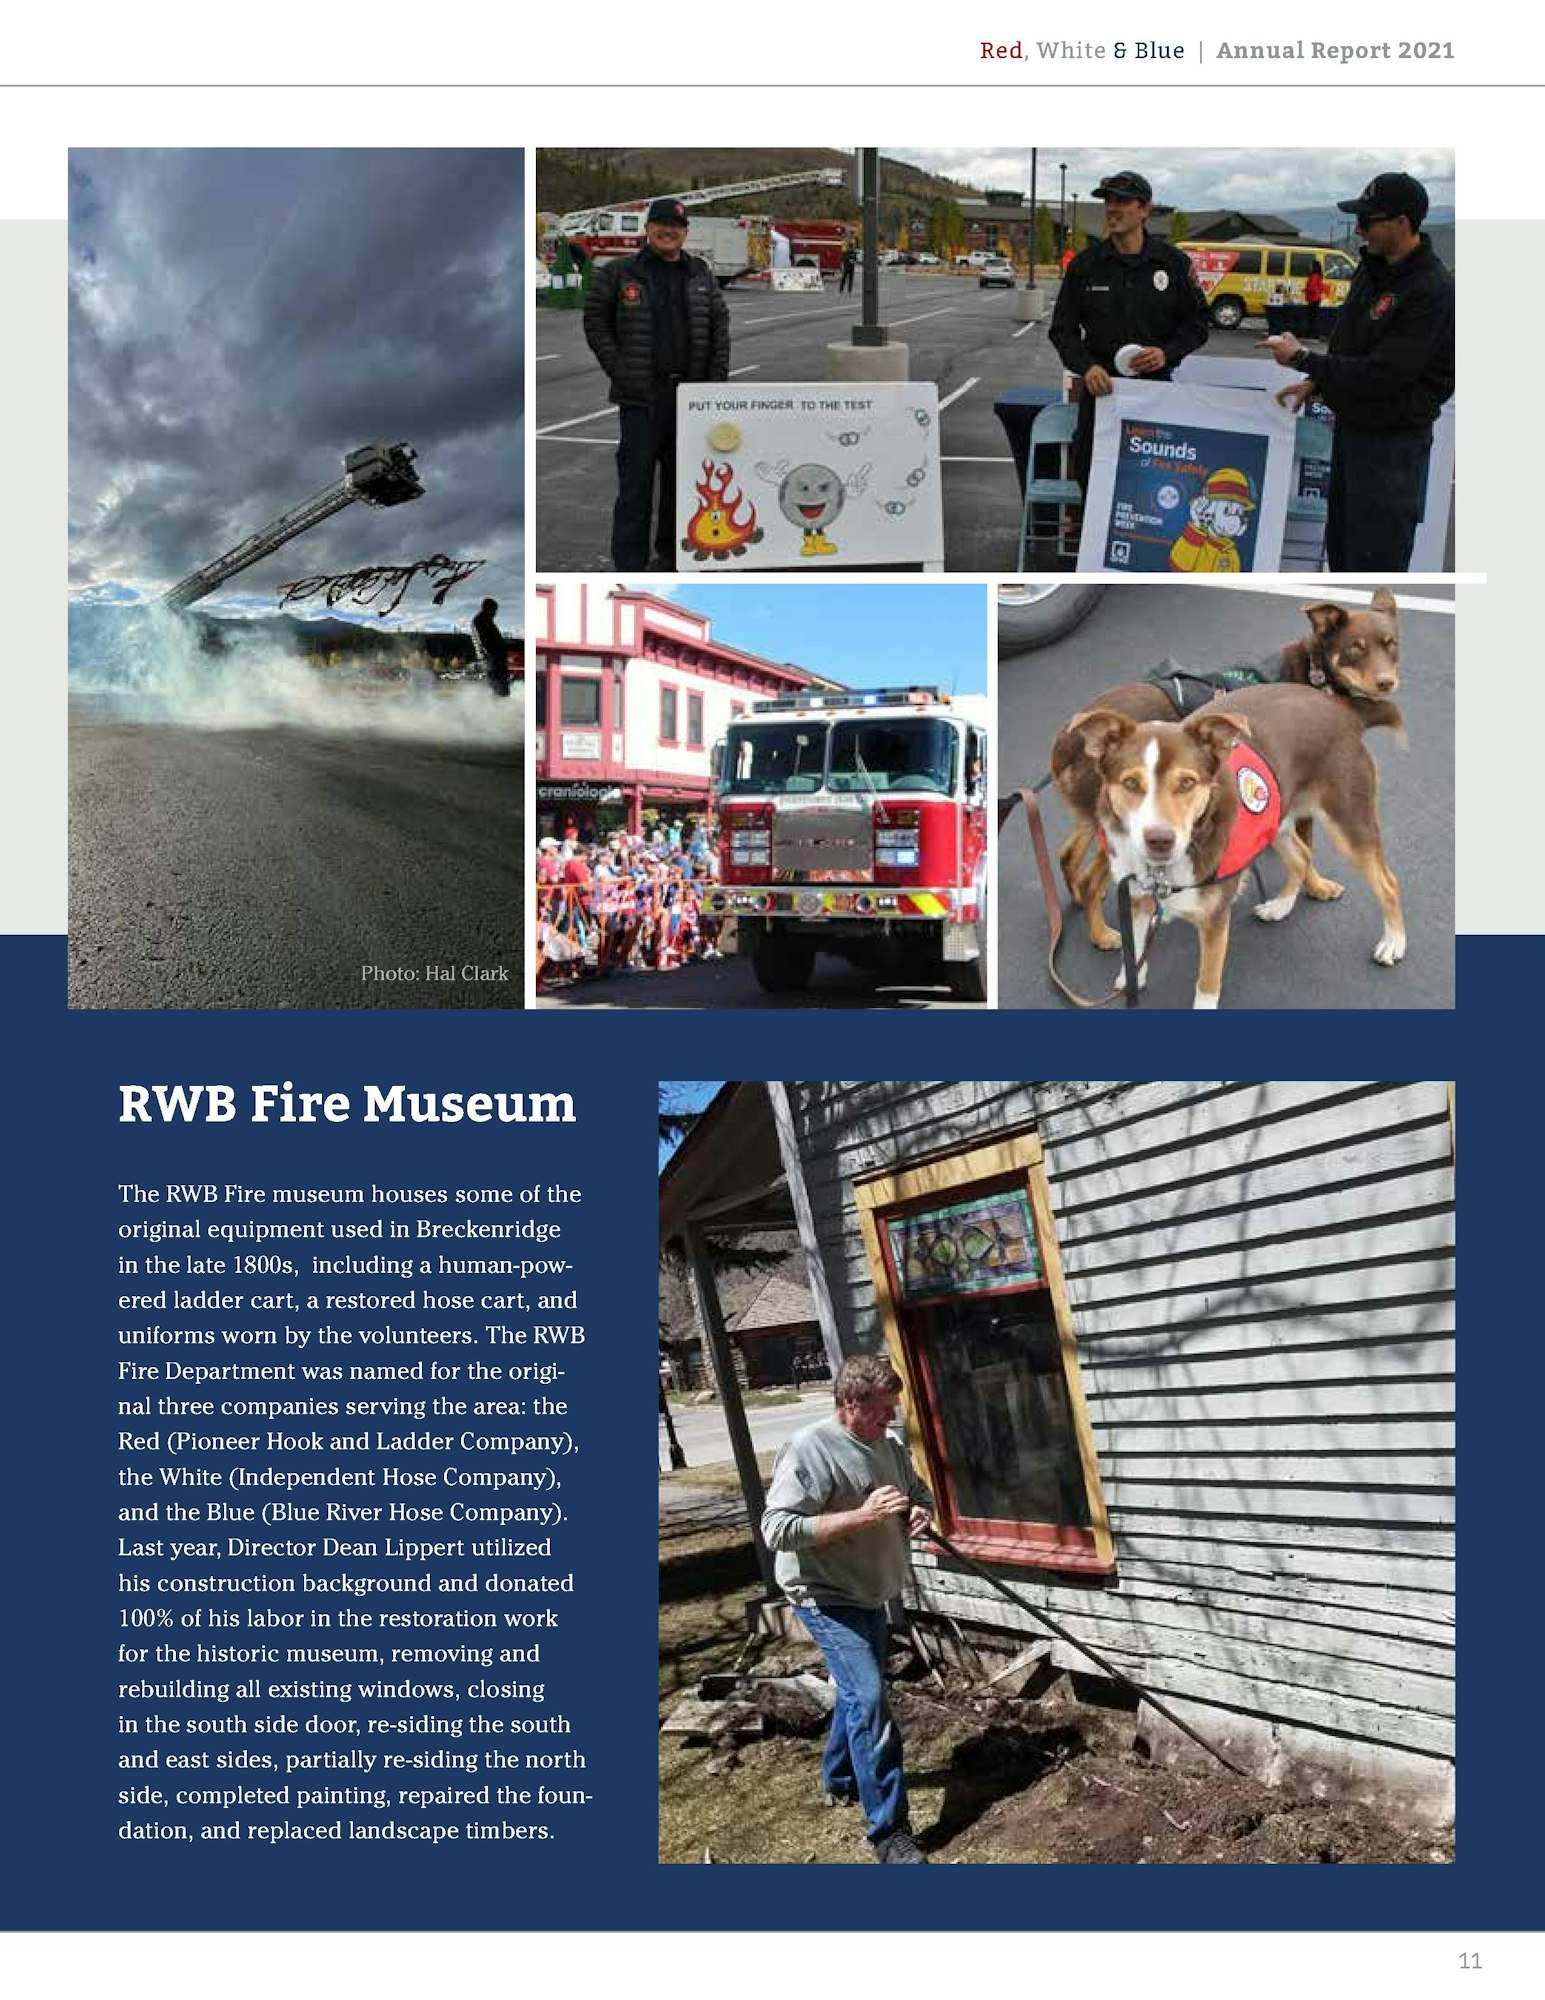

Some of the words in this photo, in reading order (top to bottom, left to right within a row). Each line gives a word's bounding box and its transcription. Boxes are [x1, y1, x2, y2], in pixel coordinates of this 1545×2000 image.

[980, 41, 1028, 61] Red,
[1036, 41, 1105, 58] White
[1114, 42, 1127, 58] &
[1135, 41, 1184, 58] Blue
[1216, 41, 1304, 58] Annual
[1311, 42, 1391, 64] Report
[1399, 42, 1454, 58] 2021
[688, 401, 711, 411] PUT
[715, 401, 748, 410] YOUR
[750, 400, 794, 410] FINGER
[801, 401, 815, 411] TO
[819, 401, 839, 411] THE
[844, 401, 872, 410] TEST
[1129, 436, 1197, 460] Sounds
[120, 1084, 236, 1122] RWB
[252, 1081, 350, 1122] Fire
[363, 1085, 576, 1122] Museum
[118, 1184, 160, 1203] The
[166, 1184, 217, 1203] RWB
[224, 1184, 265, 1203] Fire
[273, 1189, 364, 1204] museum
[372, 1184, 448, 1204] houses
[455, 1189, 513, 1204] some
[519, 1184, 540, 1203] of
[547, 1184, 582, 1203] the
[118, 1220, 200, 1242] original
[207, 1220, 325, 1242] equipment
[330, 1219, 383, 1239] used
[390, 1220, 410, 1237] in
[417, 1219, 560, 1242] Breckenridge
[119, 1257, 139, 1274] in
[145, 1254, 181, 1274] the
[187, 1255, 225, 1274] late
[234, 1254, 299, 1277] 1800s,
[312, 1254, 414, 1279] including
[419, 1260, 432, 1274] a
[439, 1254, 573, 1279] human-pow-
[118, 1290, 166, 1309] ered
[174, 1290, 243, 1310] ladder
[250, 1292, 299, 1313] cart,
[306, 1295, 319, 1310] a
[326, 1290, 416, 1310] restored
[423, 1290, 475, 1310] hose
[480, 1292, 530, 1313] cart,
[538, 1290, 577, 1310] and
[118, 1325, 216, 1344] uniforms
[221, 1330, 277, 1344] worn
[285, 1326, 311, 1348] by
[318, 1326, 353, 1344] the
[358, 1326, 477, 1345] volunteers.
[486, 1325, 527, 1344] The
[534, 1325, 586, 1344] RWB
[118, 1361, 159, 1381] Fire
[166, 1361, 296, 1385] Department
[301, 1366, 343, 1381] was
[350, 1361, 423, 1381] named
[430, 1361, 460, 1381] for
[468, 1361, 503, 1380] the
[508, 1363, 565, 1385] origi-
[118, 1396, 151, 1416] nal
[158, 1397, 215, 1415] three
[221, 1398, 339, 1420] companies
[345, 1398, 427, 1420] serving
[432, 1396, 467, 1415] the
[473, 1401, 525, 1416] area:
[533, 1397, 568, 1416] the
[118, 1431, 160, 1451] Red
[167, 1431, 261, 1455] (Pioneer
[267, 1431, 324, 1451] Hook
[329, 1432, 369, 1451] and
[377, 1431, 455, 1451] Ladder
[460, 1431, 579, 1455] Company),
[118, 1467, 153, 1486] the
[159, 1467, 222, 1487] White
[229, 1467, 376, 1491] (Independent
[383, 1467, 437, 1487] Hose
[443, 1467, 560, 1491] Company),
[118, 1503, 159, 1521] and
[166, 1503, 201, 1522] the
[207, 1502, 254, 1521] Blue
[261, 1502, 320, 1526] (Blue
[326, 1502, 382, 1521] River
[389, 1502, 444, 1522] Hose
[450, 1502, 568, 1526] Company).
[118, 1538, 164, 1556] Last
[169, 1542, 221, 1560] year,
[228, 1537, 317, 1557] Director
[323, 1537, 377, 1557] Dean
[385, 1538, 464, 1561] Lippert
[472, 1538, 551, 1557] utilized
[119, 1573, 150, 1593] his
[158, 1575, 296, 1593] construction
[303, 1573, 431, 1597] background
[438, 1573, 478, 1592] and
[485, 1573, 574, 1592] donated
[120, 1608, 174, 1628] 100%
[181, 1609, 202, 1628] of
[209, 1609, 240, 1628] his
[247, 1609, 305, 1628] labor
[310, 1609, 331, 1627] in
[338, 1609, 373, 1628] the
[380, 1609, 498, 1628] restoration
[504, 1609, 559, 1628] work
[118, 1643, 148, 1663] for
[155, 1643, 191, 1663] the
[196, 1643, 279, 1663] historic
[287, 1648, 384, 1665] museum,
[392, 1644, 494, 1667] removing
[499, 1643, 540, 1663] and
[118, 1679, 230, 1703] rebuilding
[235, 1680, 260, 1699] all
[269, 1680, 353, 1703] existing
[358, 1680, 460, 1702] windows,
[467, 1680, 545, 1702] closing
[118, 1715, 139, 1733] in
[145, 1715, 181, 1733] the
[186, 1715, 247, 1734] south
[253, 1715, 299, 1734] side
[305, 1715, 361, 1736] door,
[367, 1715, 464, 1738] re-siding
[469, 1715, 504, 1734] the
[510, 1715, 571, 1733] south
[118, 1749, 158, 1769] and
[165, 1752, 210, 1769] east
[216, 1749, 277, 1771] sides,
[285, 1749, 377, 1773] partially
[384, 1749, 478, 1773] re-siding
[484, 1749, 519, 1769] the
[526, 1749, 586, 1769] north
[117, 1785, 169, 1808] side,
[176, 1786, 290, 1808] completed
[297, 1786, 391, 1808] painting,
[398, 1786, 489, 1808] repaired
[497, 1786, 532, 1805] the
[538, 1786, 593, 1805] foun-
[118, 1821, 193, 1842] dation,
[200, 1821, 240, 1839] and
[247, 1820, 342, 1844] replaced
[348, 1820, 459, 1844] landscape
[466, 1821, 555, 1840] timbers.
[1459, 1952, 1482, 1969] 11
